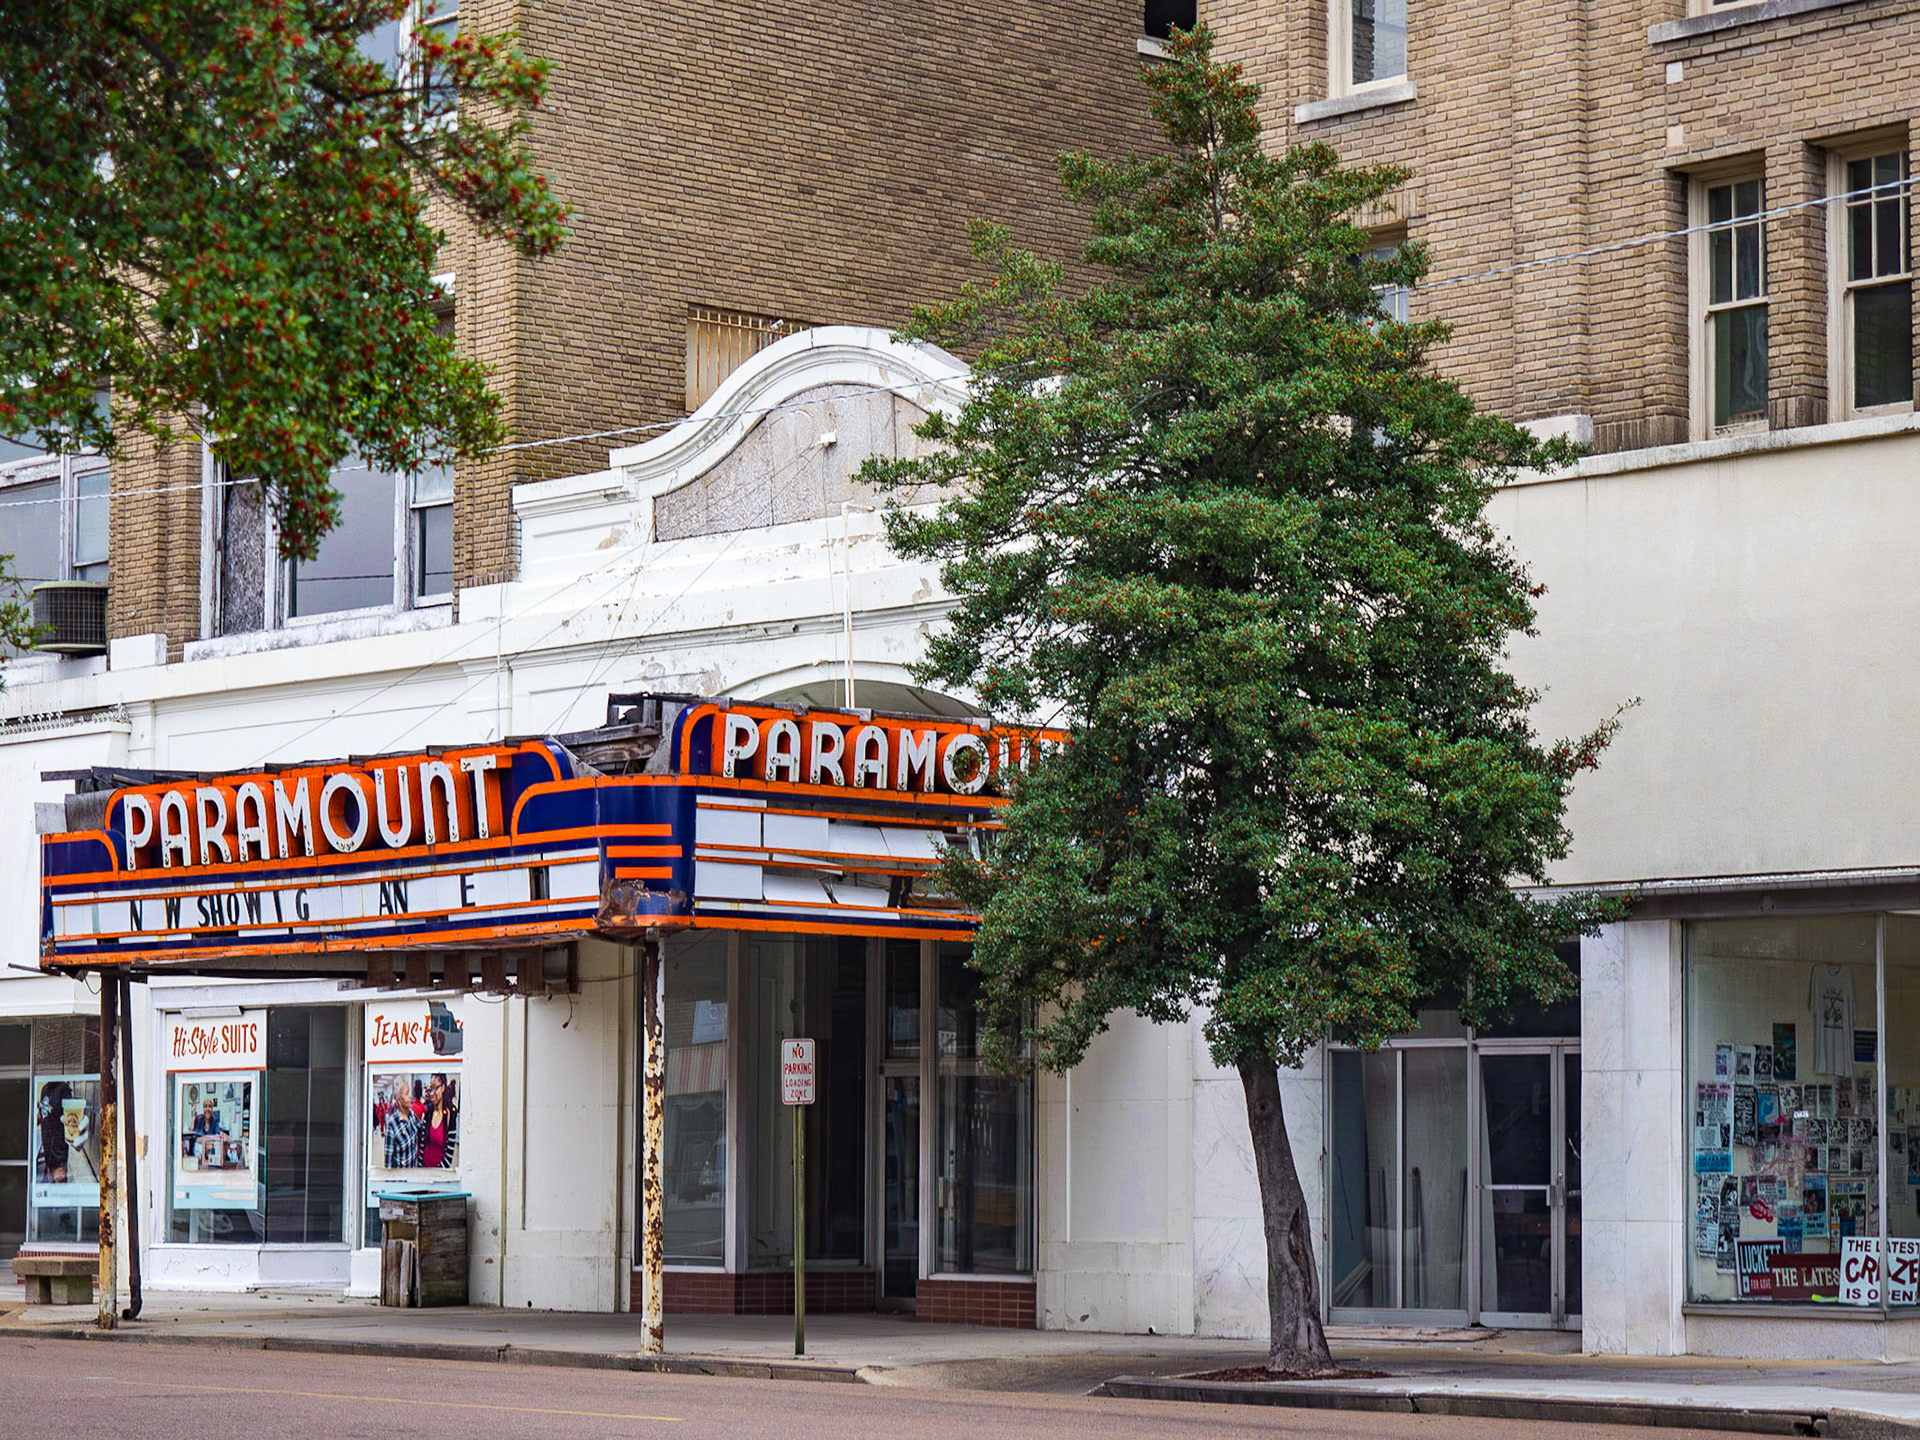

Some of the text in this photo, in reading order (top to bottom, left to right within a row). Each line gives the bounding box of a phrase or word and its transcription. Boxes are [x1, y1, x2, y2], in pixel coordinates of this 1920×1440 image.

[124, 754, 497, 871] PARAMOUNT
[221, 1023, 257, 1053] SUITS
[792, 1046, 804, 1059] NO
[785, 1062, 812, 1075] PARKING
[786, 1079, 811, 1087] LOADING
[791, 1089, 807, 1098] ZONE
[1848, 1239, 1871, 1252] THE
[1772, 1267, 1799, 1288] THE
[1846, 1288, 1861, 1299] IS
